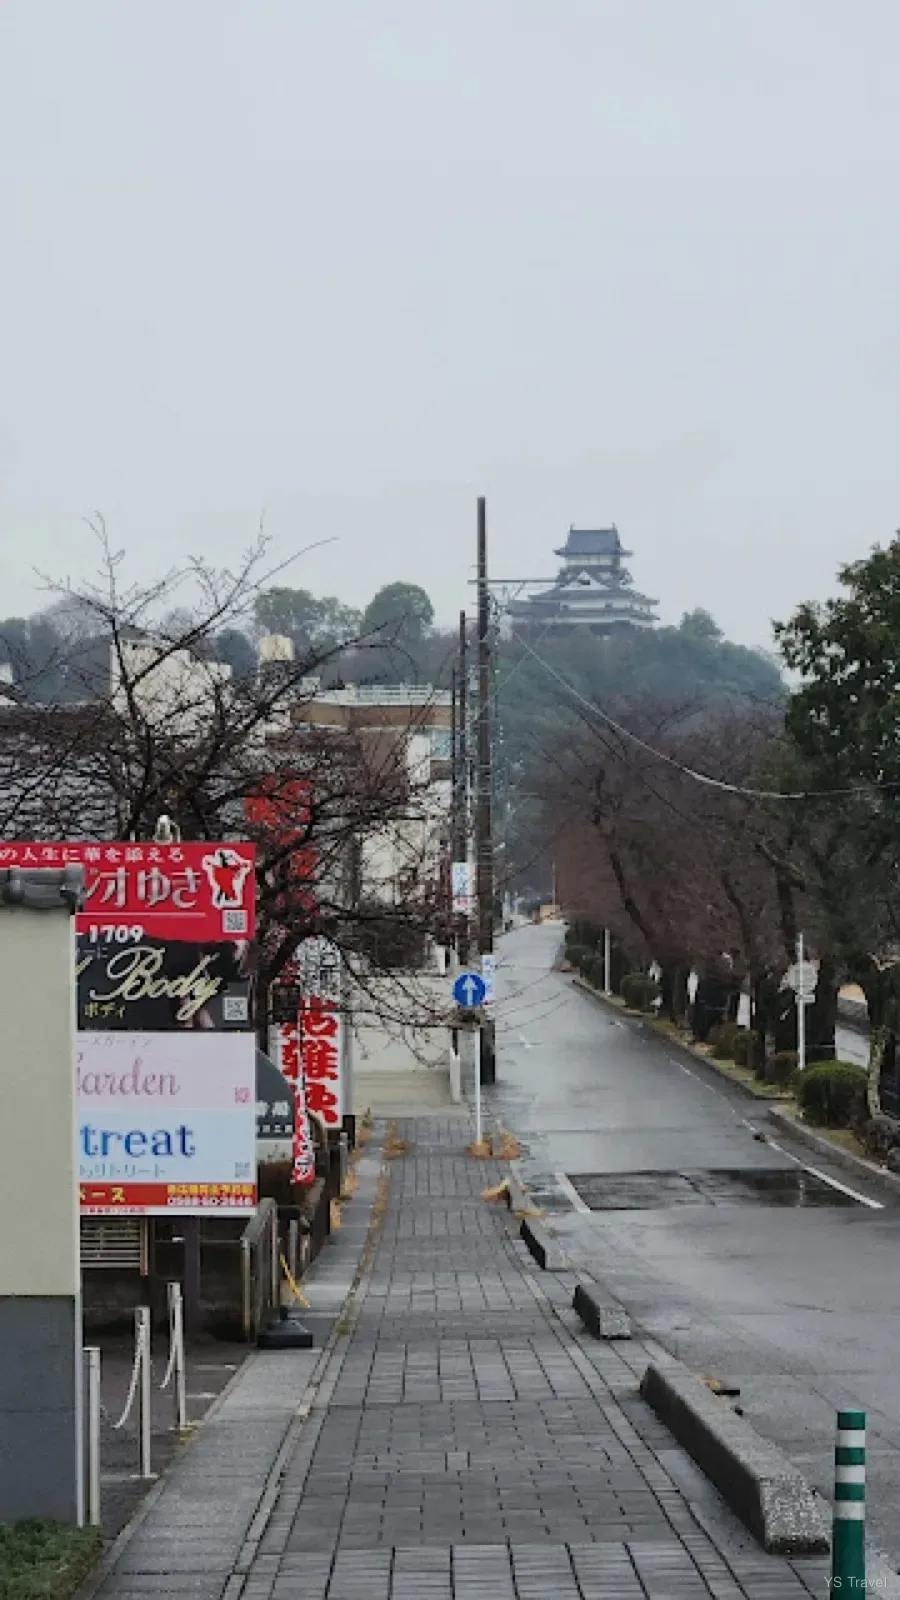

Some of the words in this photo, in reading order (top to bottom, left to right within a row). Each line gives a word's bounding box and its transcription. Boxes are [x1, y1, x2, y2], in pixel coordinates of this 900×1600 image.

[0, 847, 184, 862] の人生に華を添える
[89, 946, 223, 1020] Body
[77, 1052, 181, 1096] arden
[80, 1124, 196, 1158] treat
